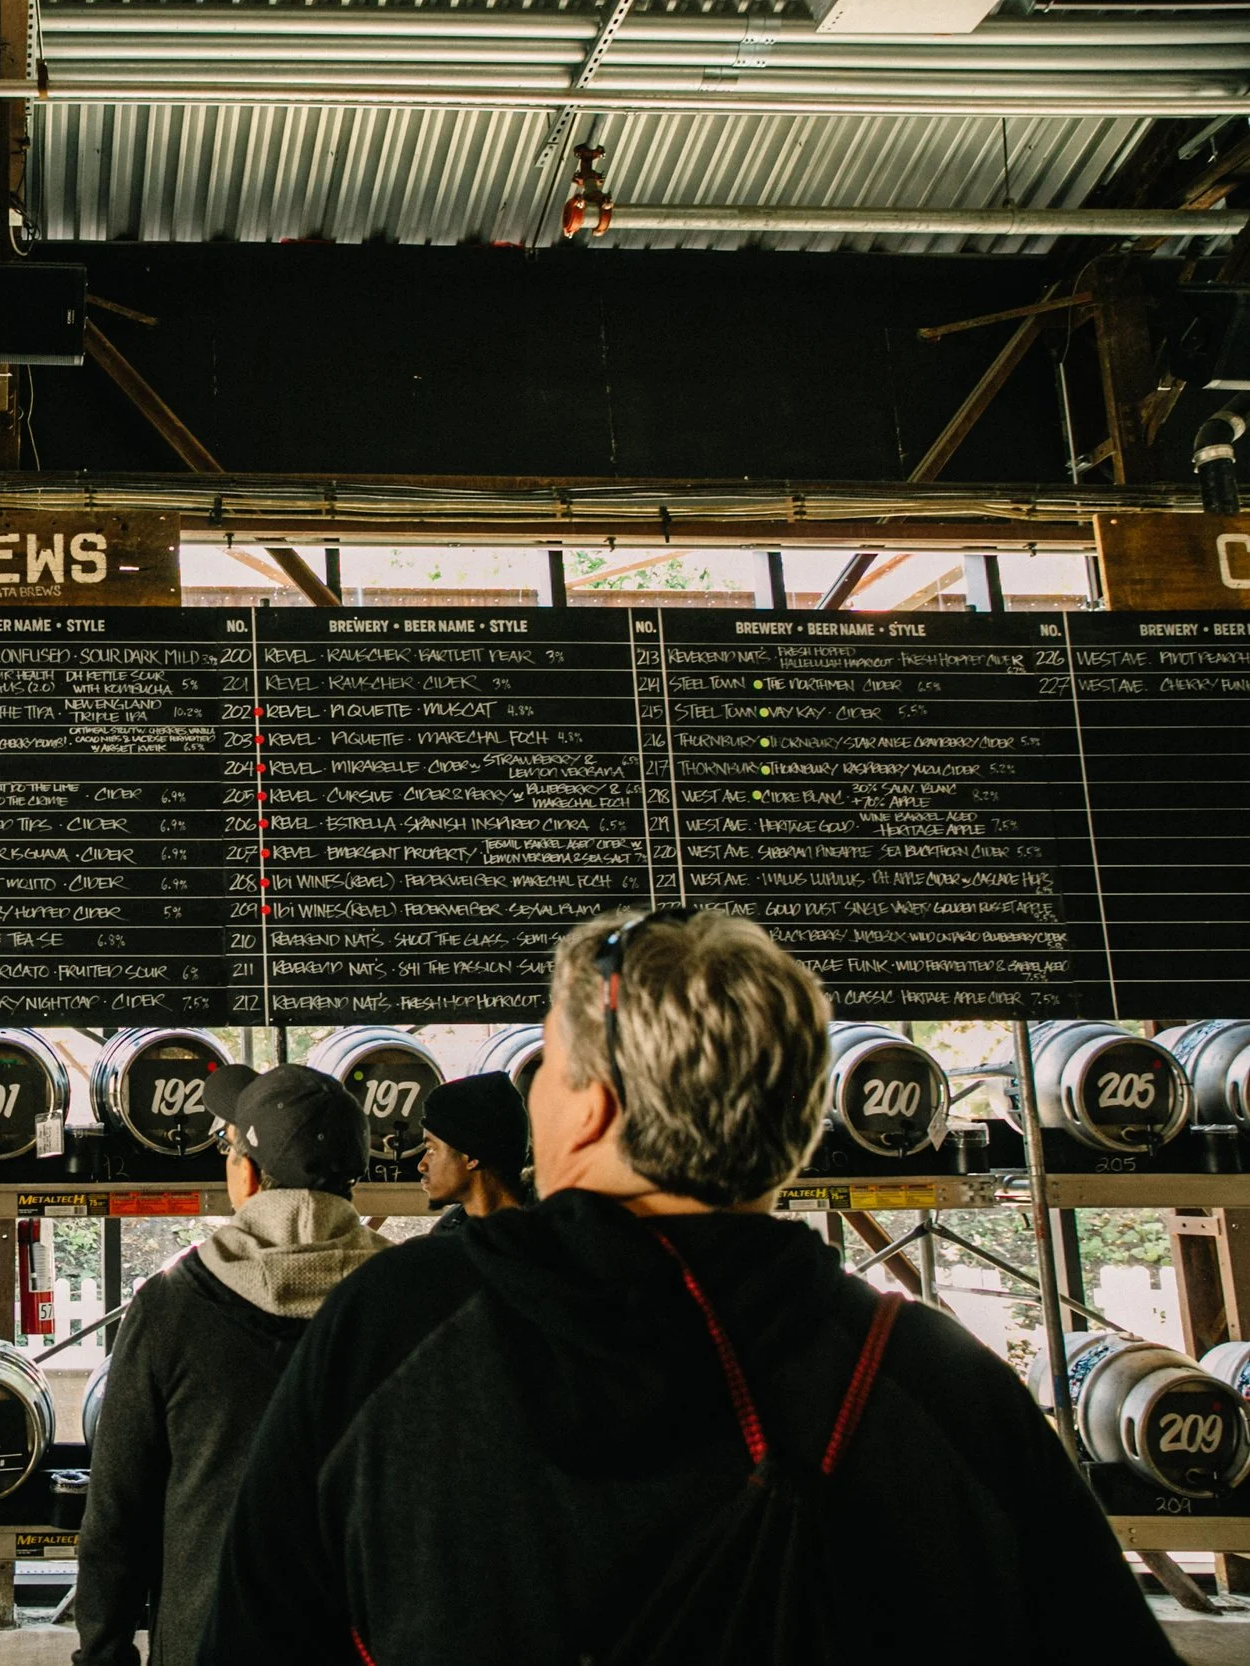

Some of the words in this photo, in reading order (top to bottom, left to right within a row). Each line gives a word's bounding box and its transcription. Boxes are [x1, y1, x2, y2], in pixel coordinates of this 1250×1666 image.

[19, 585, 61, 597] BREWS
[15, 619, 51, 632] NAME
[66, 618, 105, 632] STYLE
[227, 620, 248, 633] NO.
[329, 620, 389, 633] BREWERY
[404, 619, 436, 633] BEER
[438, 619, 475, 633] NAME
[490, 619, 528, 633] STYLE
[636, 621, 657, 634] NO.
[736, 622, 793, 636] BREWERY
[808, 622, 839, 636] BEER
[840, 622, 874, 636] NAME
[889, 622, 926, 637] STYLE
[1040, 624, 1062, 637] NO.
[1140, 624, 1198, 636] BREWERY
[1214, 624, 1245, 635] BEER
[164, 649, 200, 665] MILD
[220, 649, 252, 664] 200
[264, 649, 317, 663] REVEL
[546, 650, 564, 664] 3%
[636, 649, 659, 666] 213
[1036, 651, 1065, 665] 226
[222, 676, 249, 691] 201
[423, 675, 481, 690] CIDER
[638, 676, 660, 693] 214
[1039, 677, 1071, 696] 227
[221, 704, 252, 720] 202
[266, 703, 320, 718] REVEL
[423, 702, 497, 718] MUSCAT
[836, 706, 881, 721] CIDER
[268, 732, 318, 746] REVEL
[224, 760, 254, 776] 204
[268, 761, 322, 775] REVEL
[225, 789, 255, 804] 205
[327, 788, 393, 803] CURSIVE
[66, 817, 129, 833] CIDER
[160, 818, 186, 832] 6.9%
[225, 817, 257, 833] 206
[270, 817, 318, 830] REVEL
[326, 817, 396, 831] ESTRELLA
[69, 875, 130, 891] CIDER
[656, 871, 676, 888] 221
[72, 905, 129, 921] CIDER
[163, 905, 182, 918] 5%
[230, 902, 257, 919] 209
[182, 966, 199, 980] 6%
[112, 994, 173, 1011] CIDER
[232, 994, 258, 1011] 212
[151, 1077, 205, 1116] 192
[363, 1079, 421, 1118] 197
[863, 1078, 921, 1118] 200
[1098, 1072, 1155, 1109] 205
[1095, 1156, 1136, 1173] 205
[19, 1194, 85, 1206] METALTECH
[773, 1187, 827, 1198] ETALTECH
[1159, 1413, 1223, 1452] 209
[1156, 1497, 1191, 1514] 209
